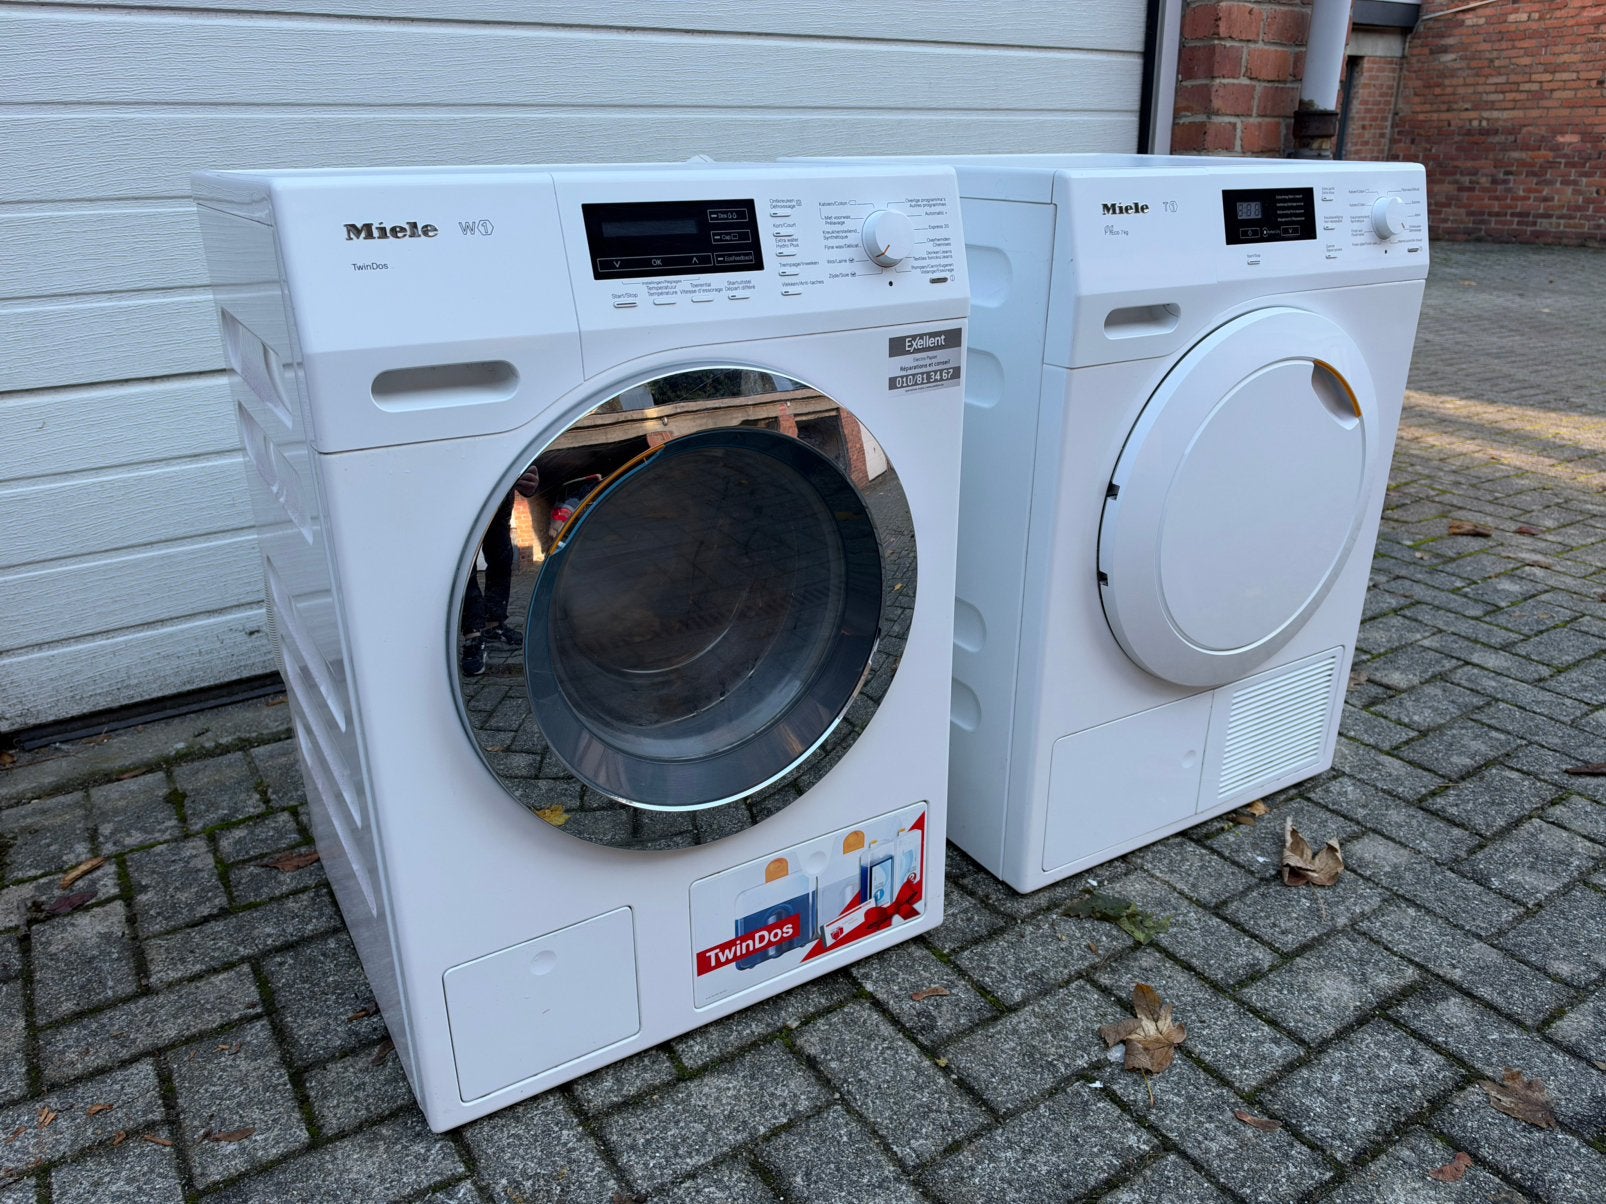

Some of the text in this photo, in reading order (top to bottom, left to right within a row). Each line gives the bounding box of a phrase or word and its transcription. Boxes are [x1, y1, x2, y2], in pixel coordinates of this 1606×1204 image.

[1101, 202, 1149, 215] Miele
[343, 221, 438, 240] Miele
[352, 262, 388, 272] TwinDos
[906, 334, 946, 352] Exellent
[900, 363, 928, 373] Réparations
[896, 374, 928, 388] 010/81
[930, 371, 940, 382] 34
[942, 369, 954, 380] 67
[706, 924, 794, 968] TwinDos
